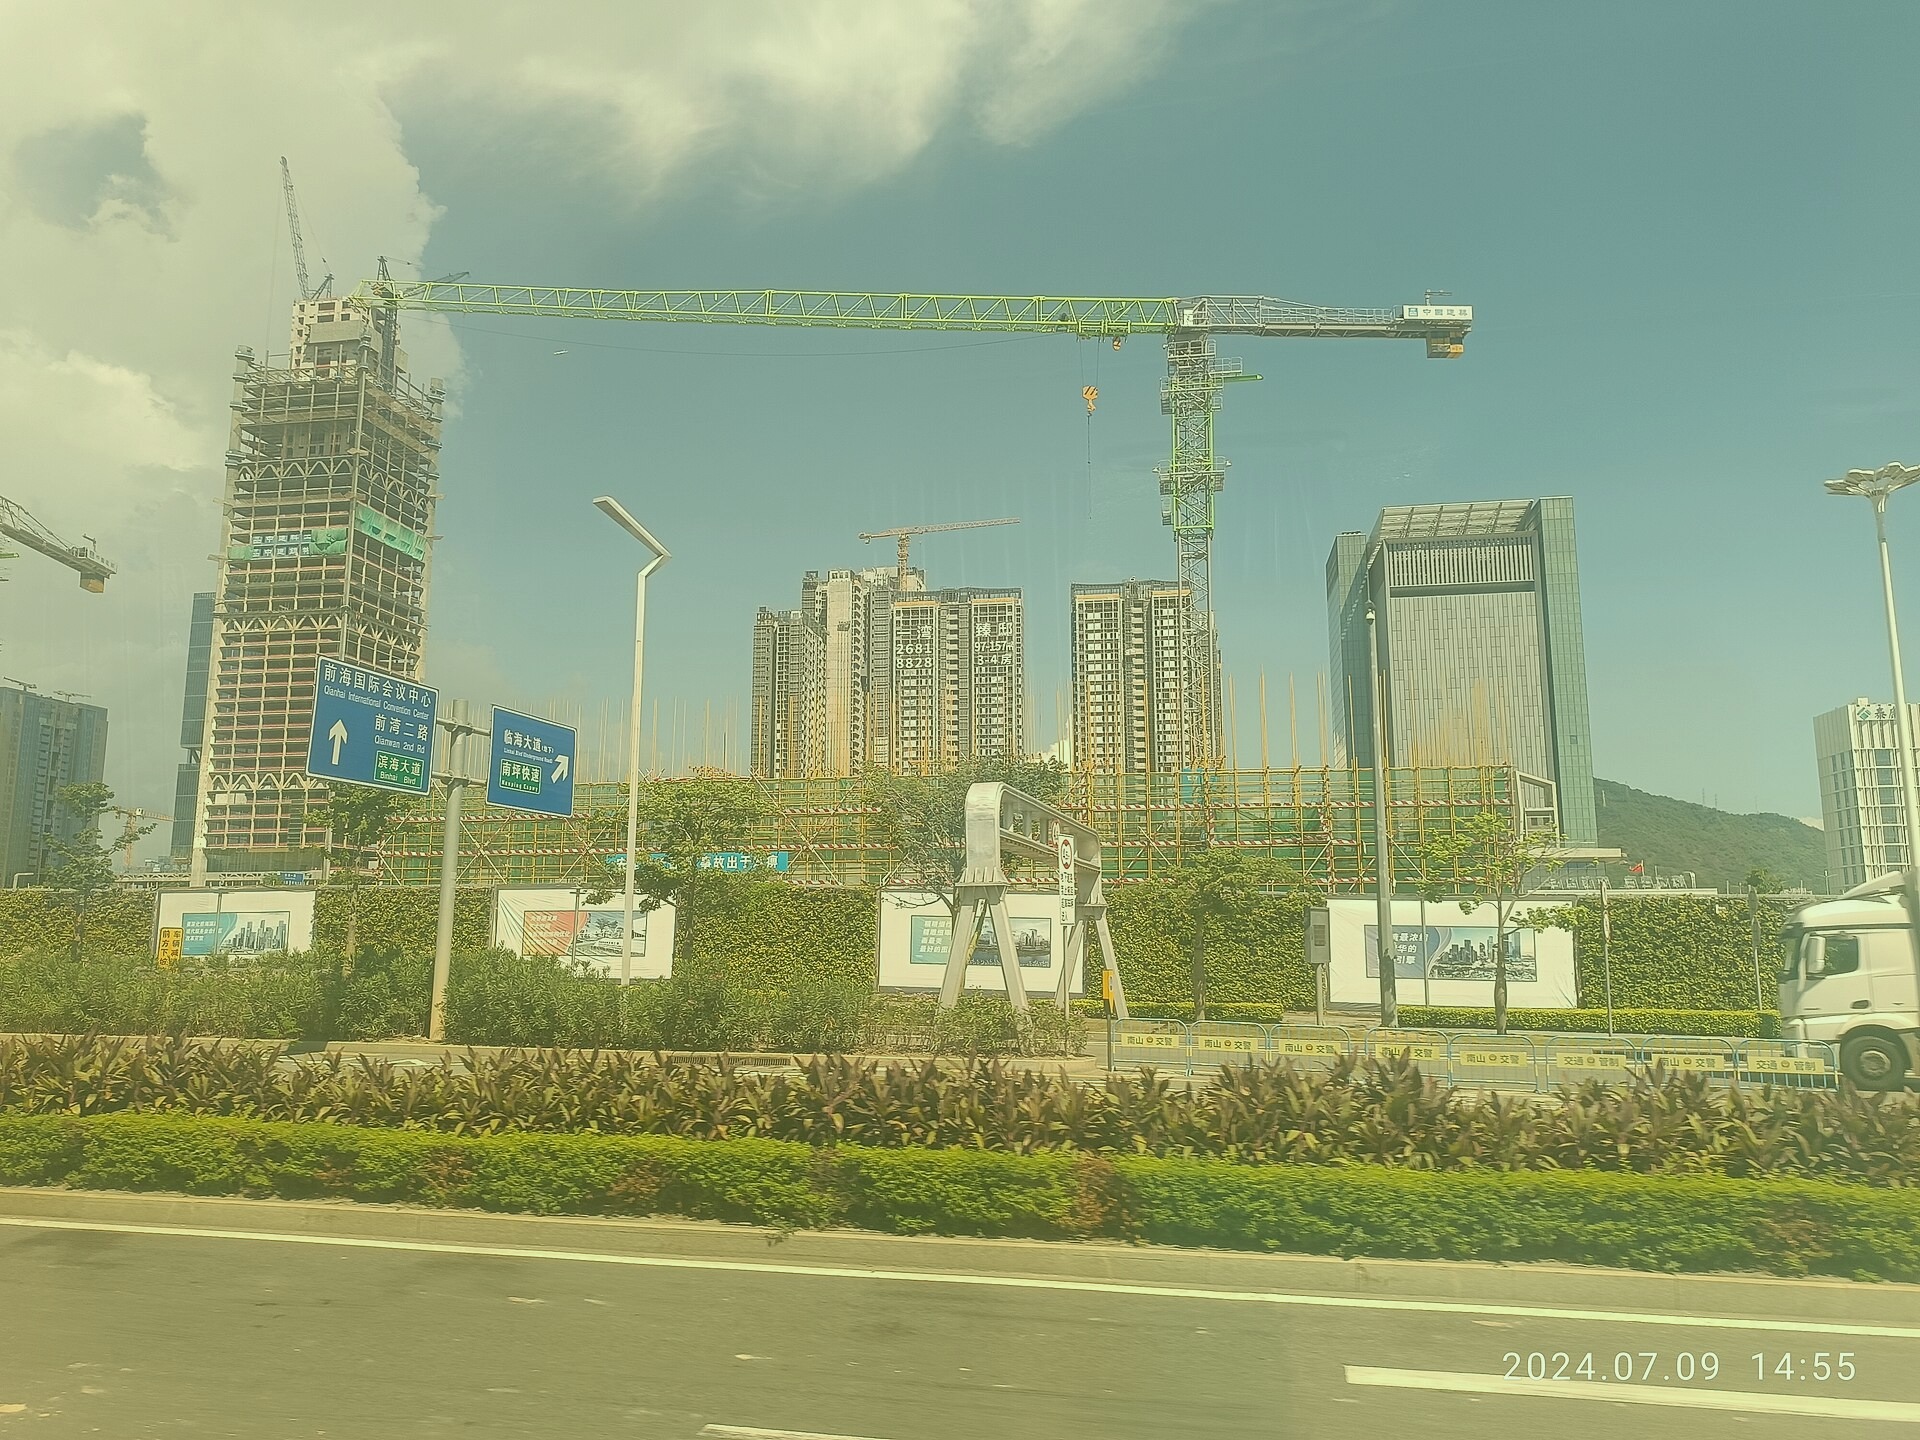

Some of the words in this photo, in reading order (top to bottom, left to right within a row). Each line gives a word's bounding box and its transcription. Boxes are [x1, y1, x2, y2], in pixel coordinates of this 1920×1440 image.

[896, 643, 933, 655] 2681
[896, 657, 933, 669] 8828
[324, 662, 432, 708] 前海国际会议中心
[324, 685, 346, 699] Qianhai
[348, 691, 381, 708] International
[383, 700, 411, 716] Convention
[412, 708, 430, 720] Center
[374, 713, 429, 742] 前湾二路
[374, 734, 400, 749] Qianwan
[402, 741, 415, 752] 2nd
[416, 744, 425, 754] Rd
[377, 754, 422, 777] 滨海大道
[502, 761, 540, 783] 南坪快速
[380, 771, 398, 781] Binhai
[403, 776, 417, 785] Blvd
[700, 854, 779, 870] 事故出于痹
